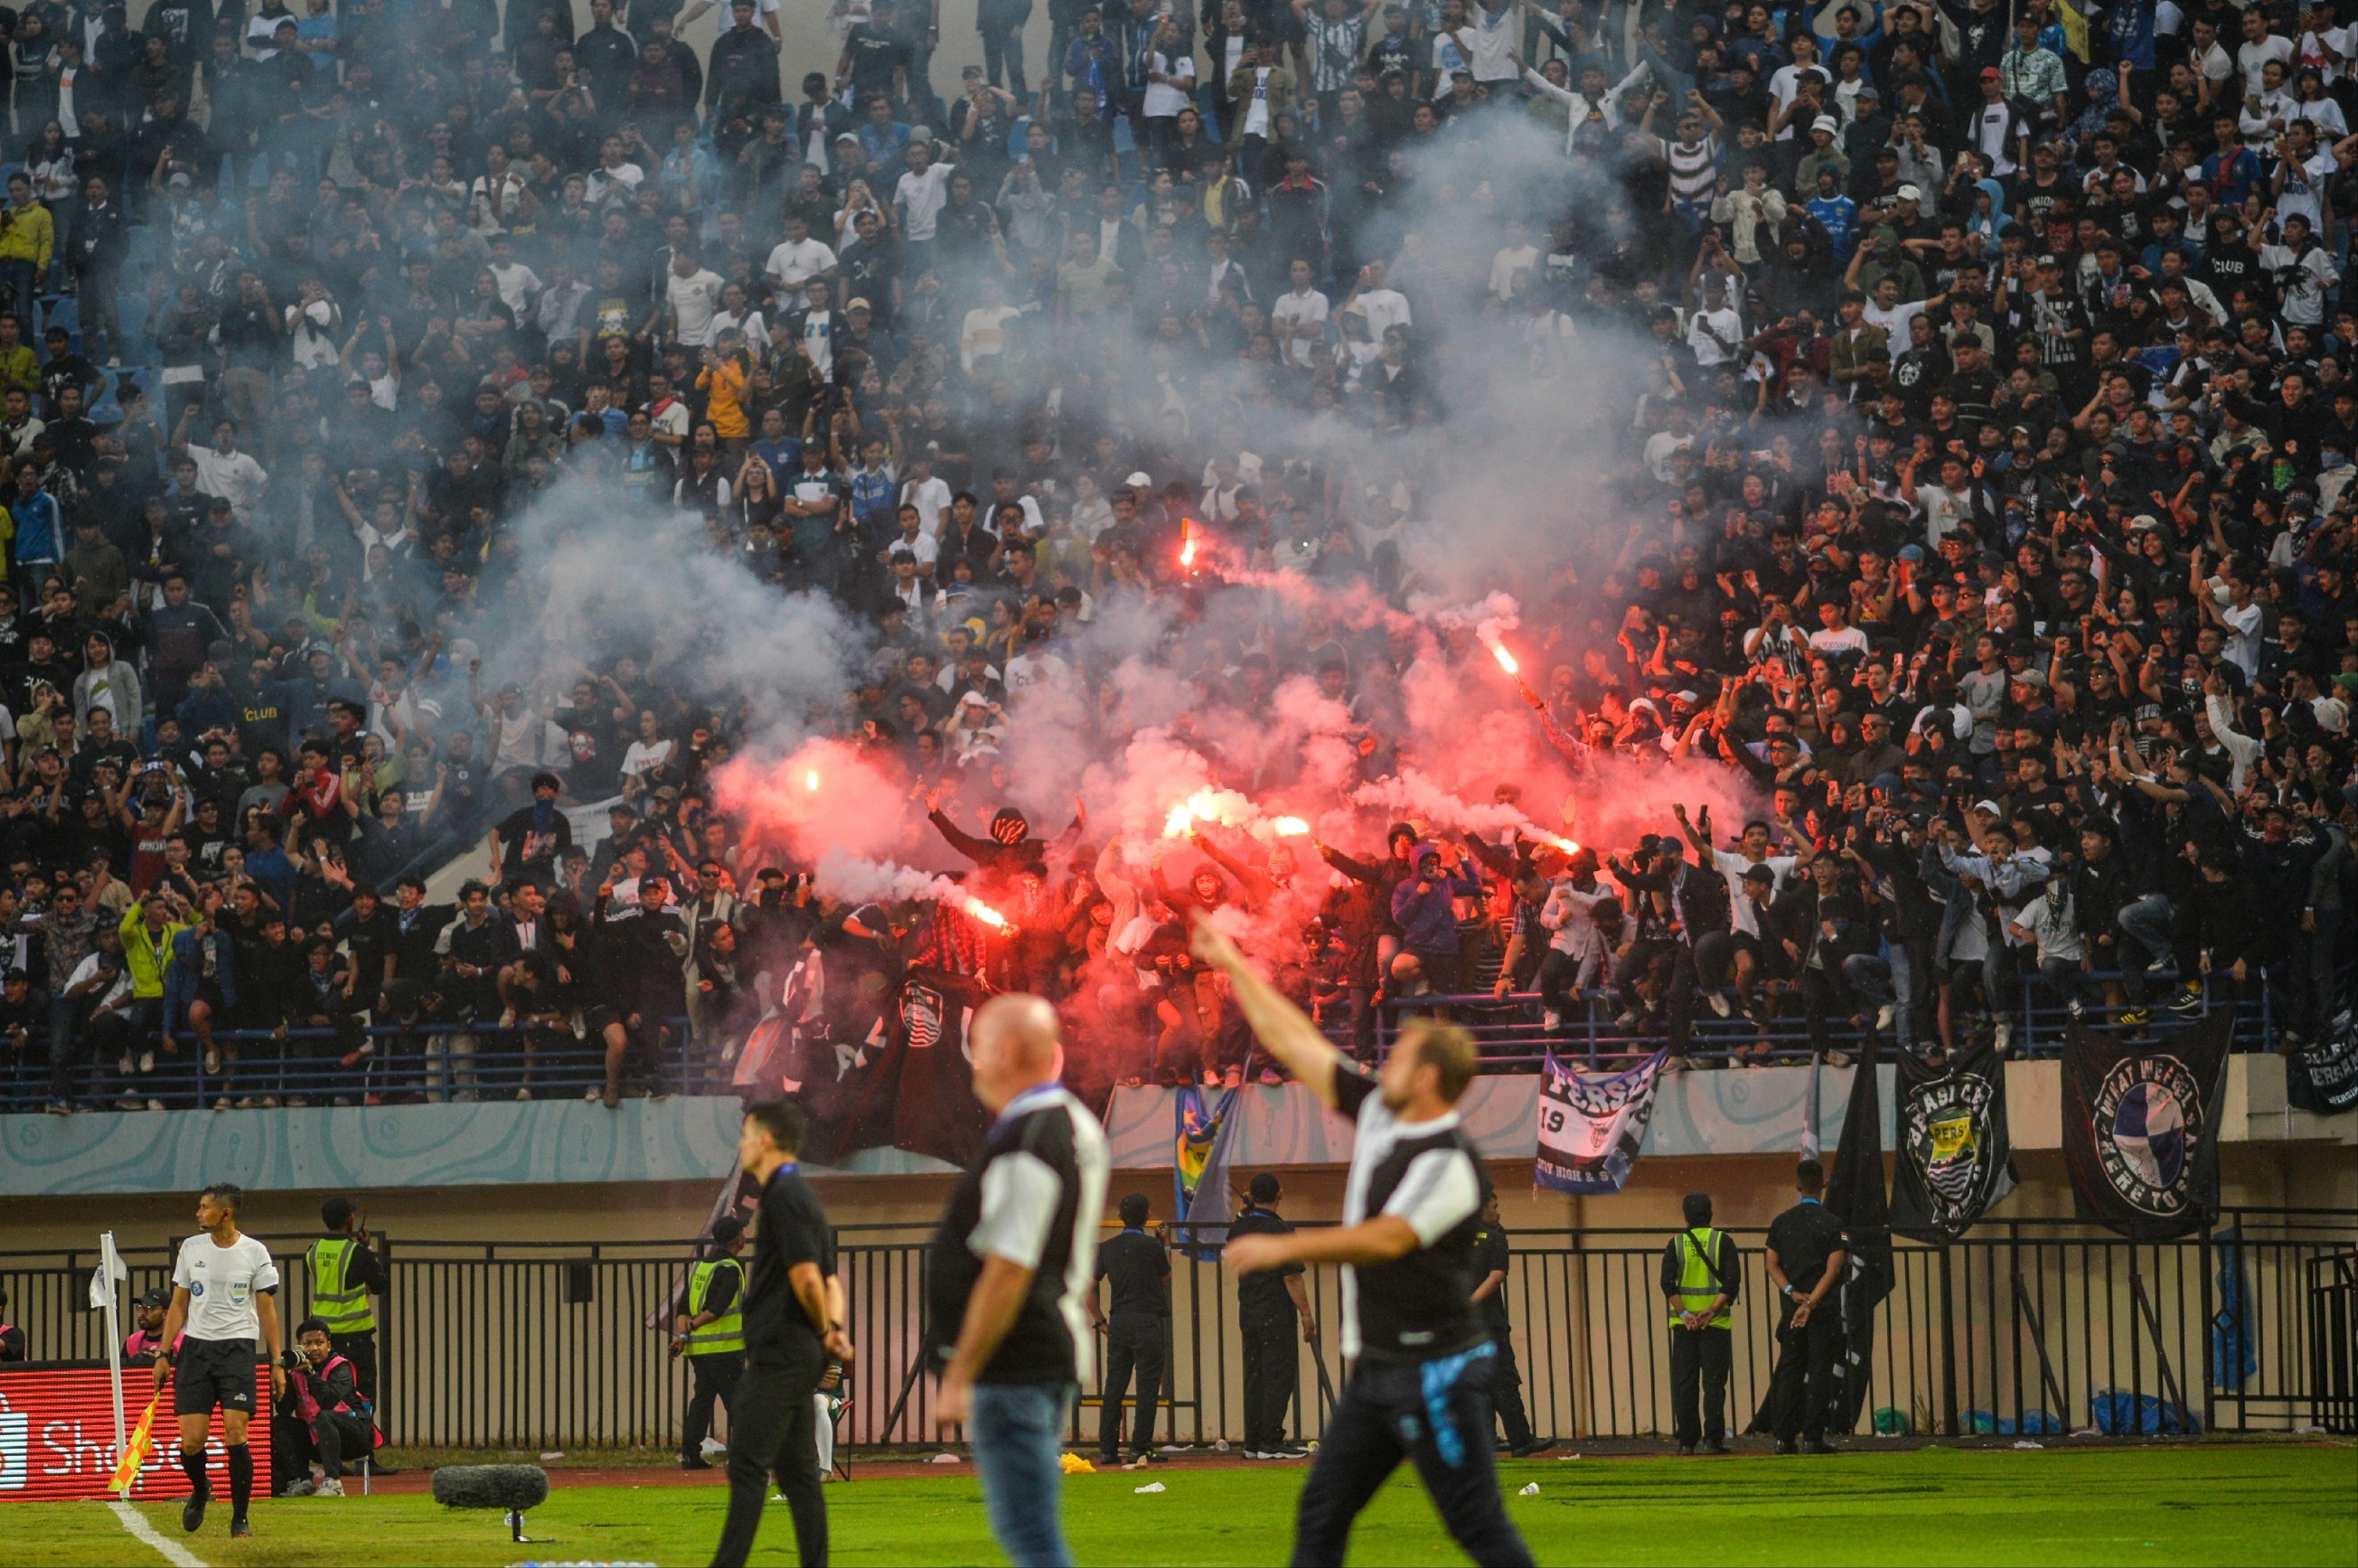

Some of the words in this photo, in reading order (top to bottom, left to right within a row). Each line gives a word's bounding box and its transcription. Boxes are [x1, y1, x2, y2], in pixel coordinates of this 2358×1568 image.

[244, 707, 277, 722] CLUB
[2100, 1065, 2135, 1118] WHAT
[1933, 1122, 1968, 1141] PERS
[1555, 1166, 1583, 1182] HIGH
[1584, 1172, 1596, 1183] &
[2151, 1189, 2178, 1209] TO
